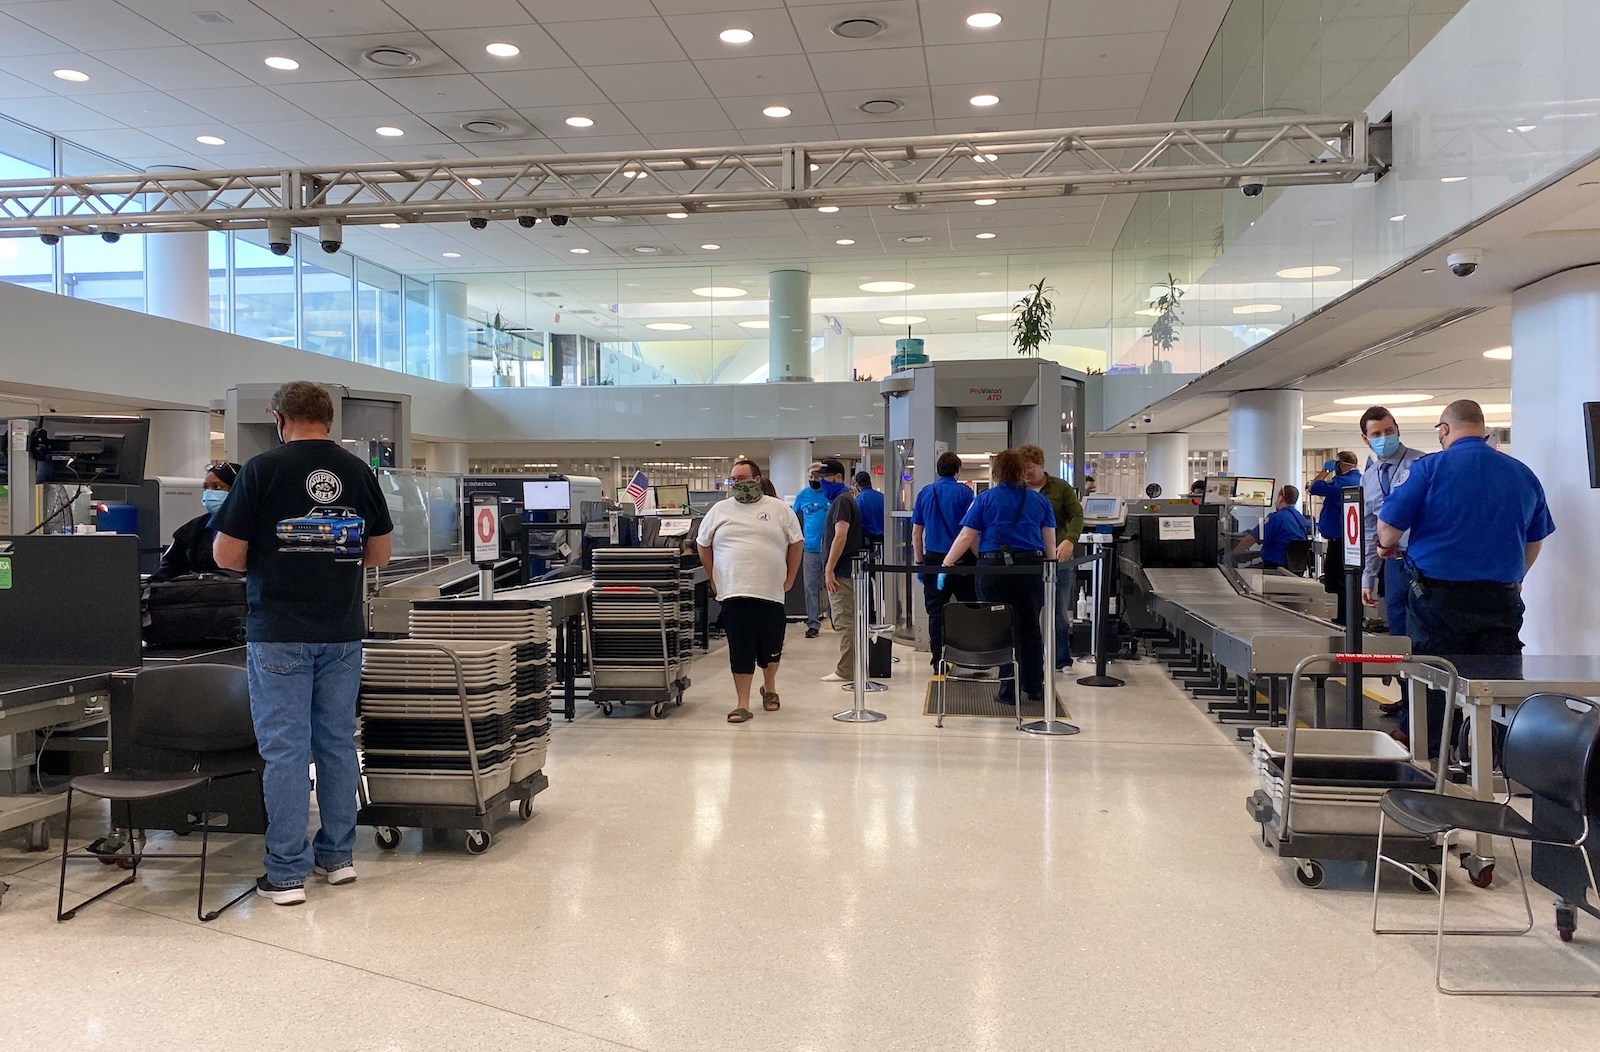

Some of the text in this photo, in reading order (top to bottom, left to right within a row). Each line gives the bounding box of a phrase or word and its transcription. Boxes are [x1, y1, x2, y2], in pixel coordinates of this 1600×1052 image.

[970, 387, 1002, 395] ProVision
[860, 435, 869, 446] 4
[310, 474, 336, 488] SUPER
[315, 490, 335, 499] BEE
